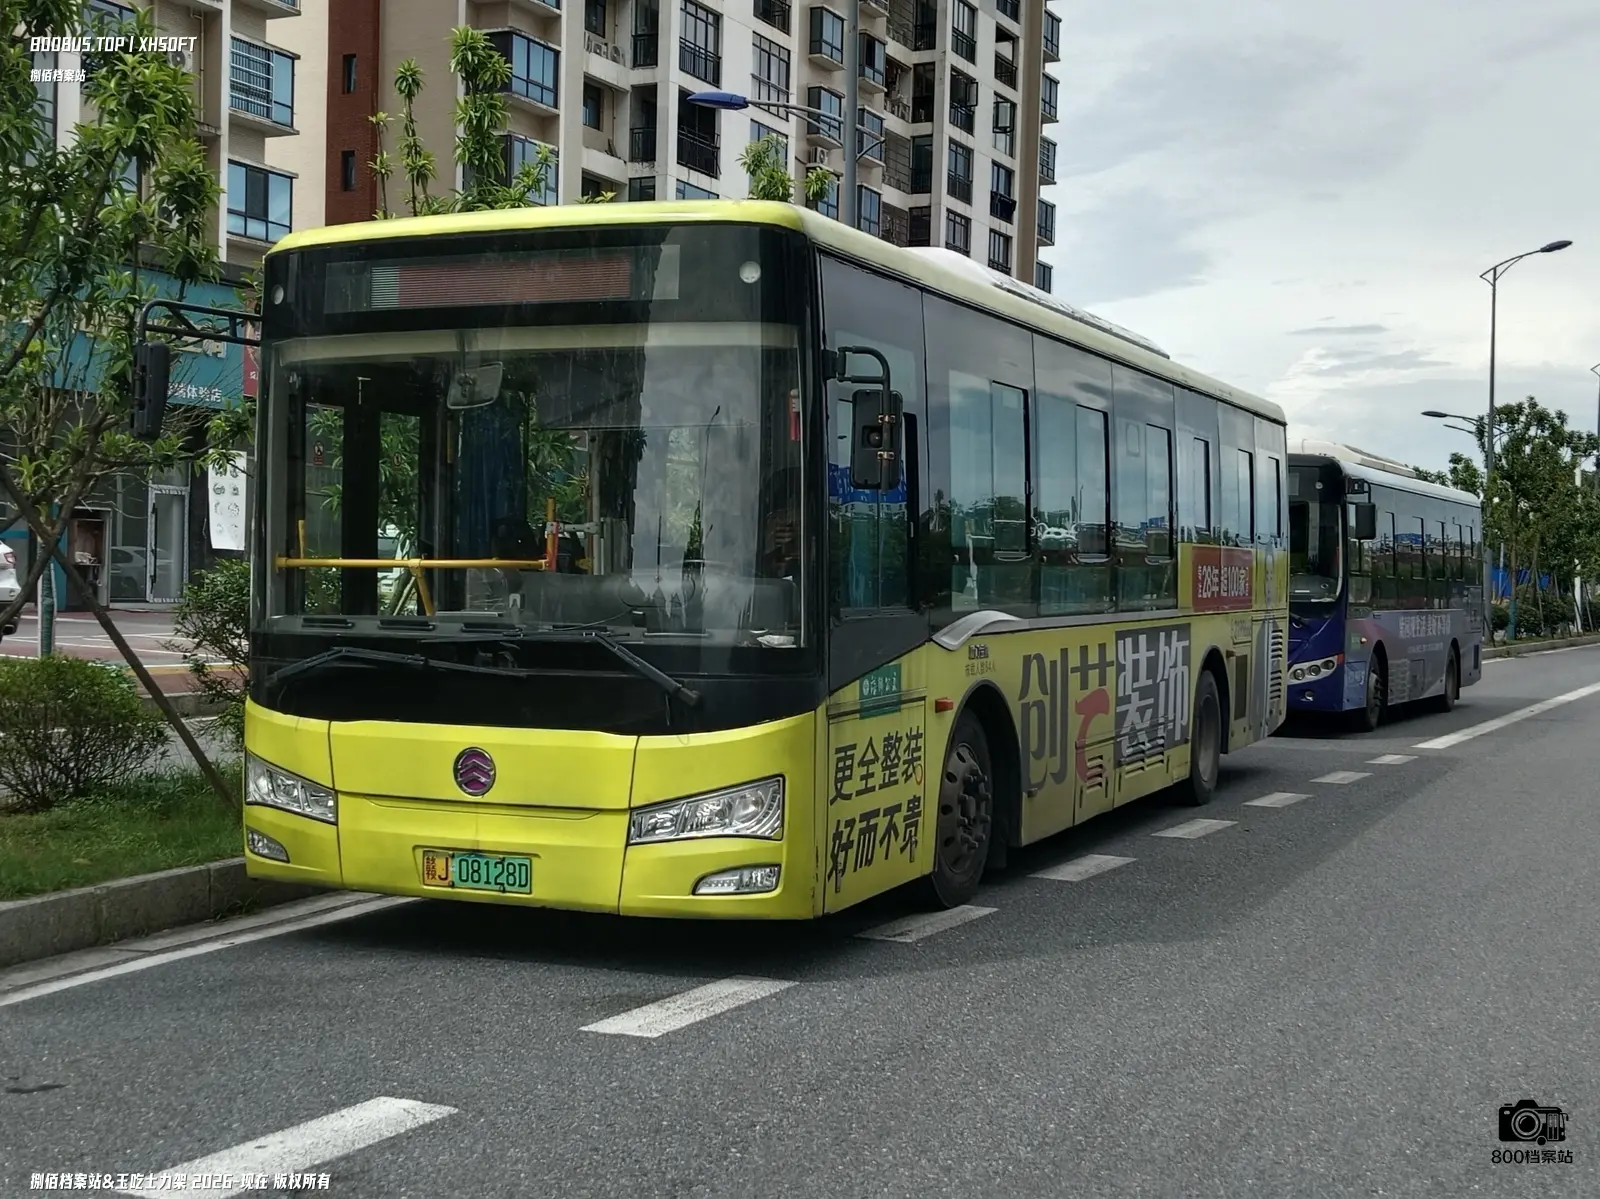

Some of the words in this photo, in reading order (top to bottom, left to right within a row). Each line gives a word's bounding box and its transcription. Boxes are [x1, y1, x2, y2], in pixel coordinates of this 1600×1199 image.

[829, 726, 923, 806] 更全整装
[828, 795, 922, 893] 好而不贵
